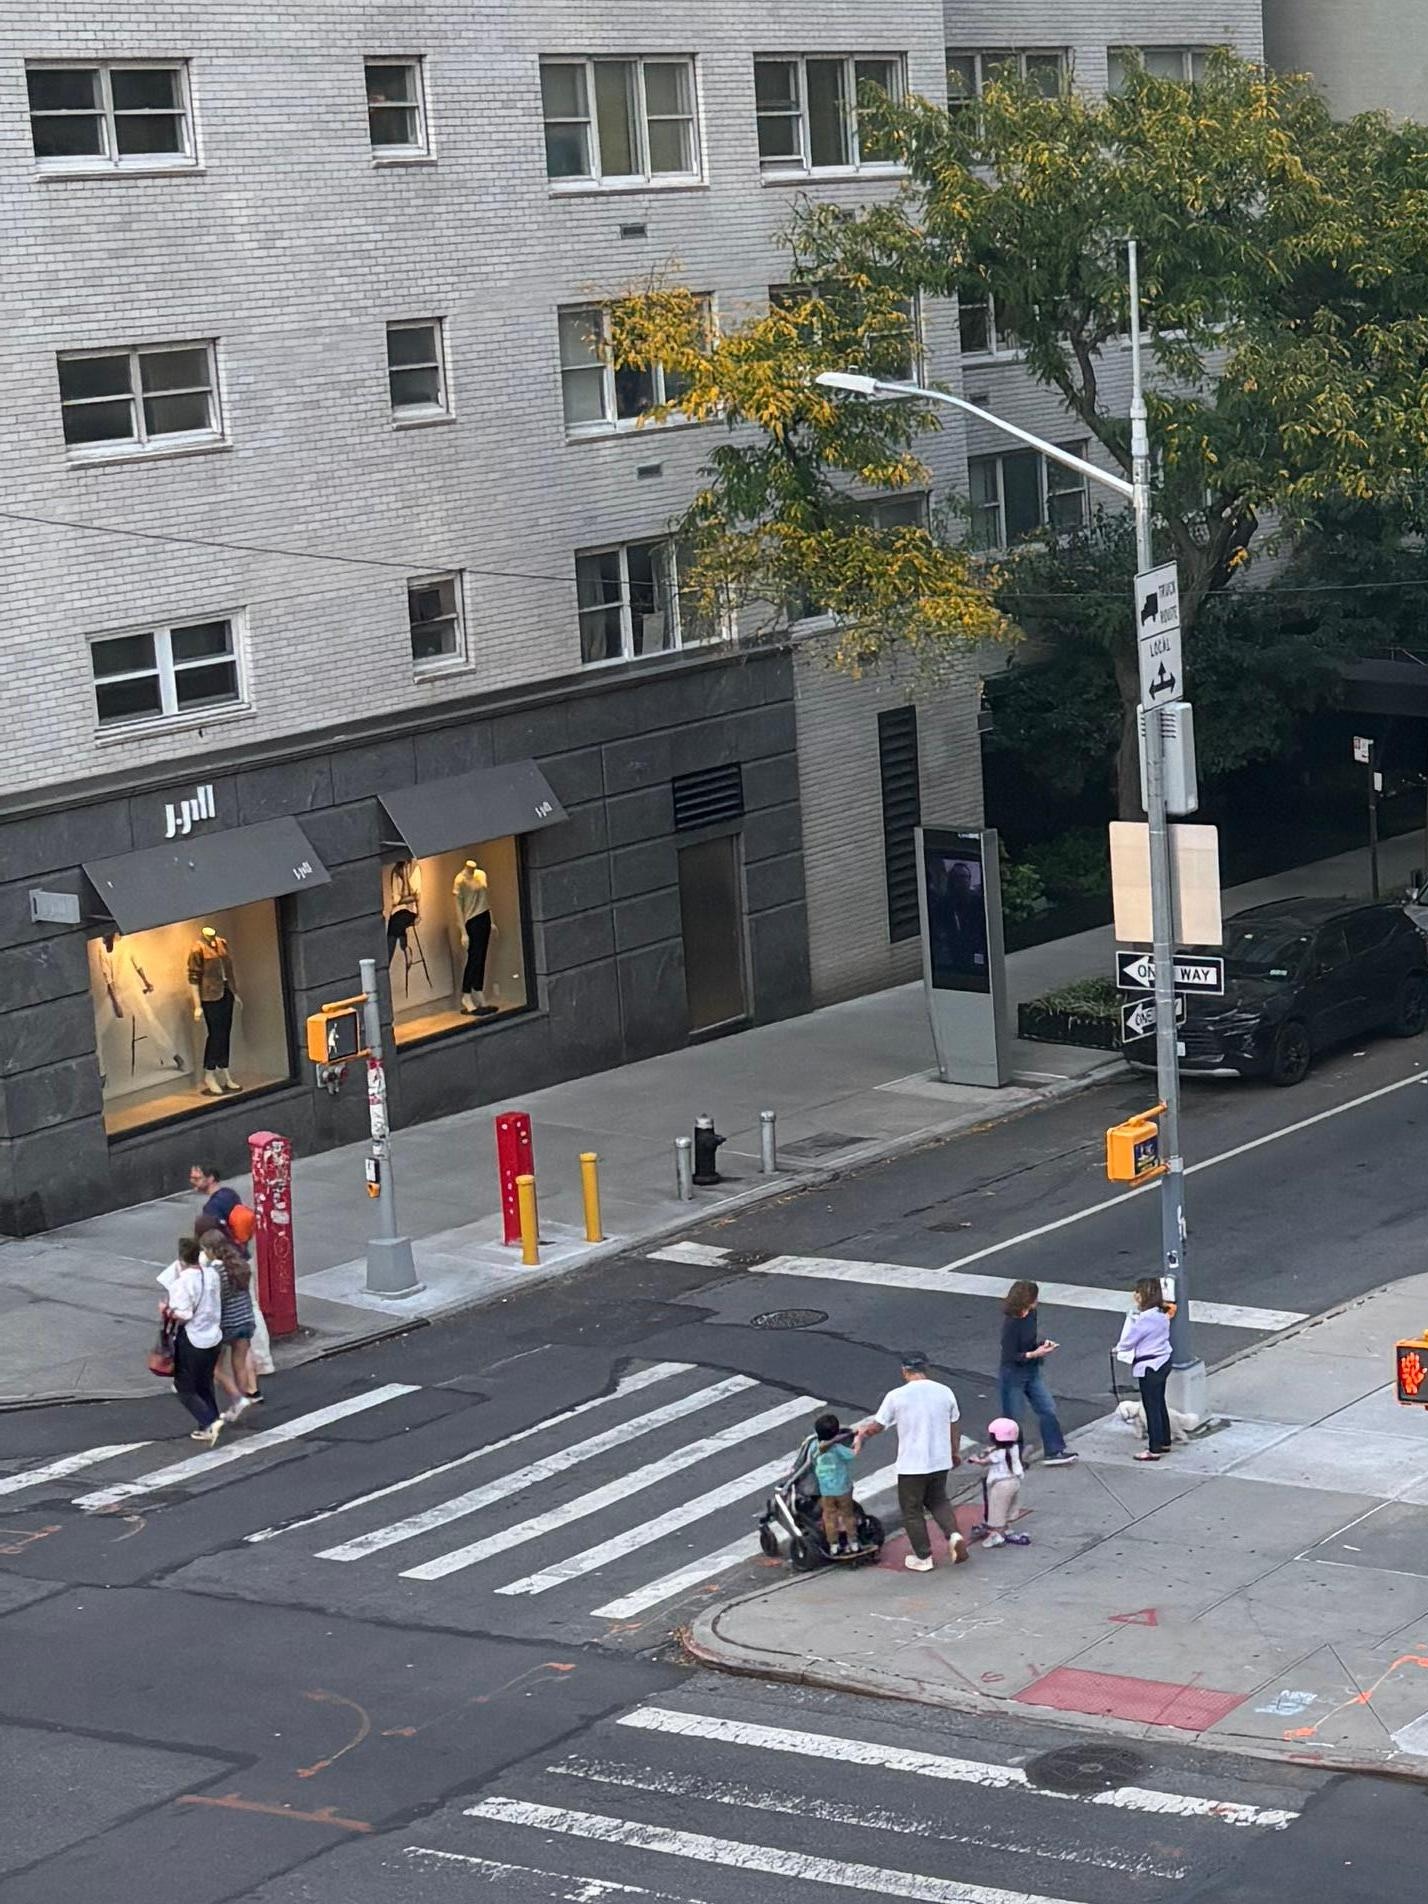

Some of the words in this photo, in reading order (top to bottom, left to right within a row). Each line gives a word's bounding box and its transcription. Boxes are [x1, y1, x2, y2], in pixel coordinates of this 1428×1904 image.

[1149, 635, 1172, 658] LOCAL
[1137, 964, 1156, 978] ON
[1180, 967, 1210, 981] WAY
